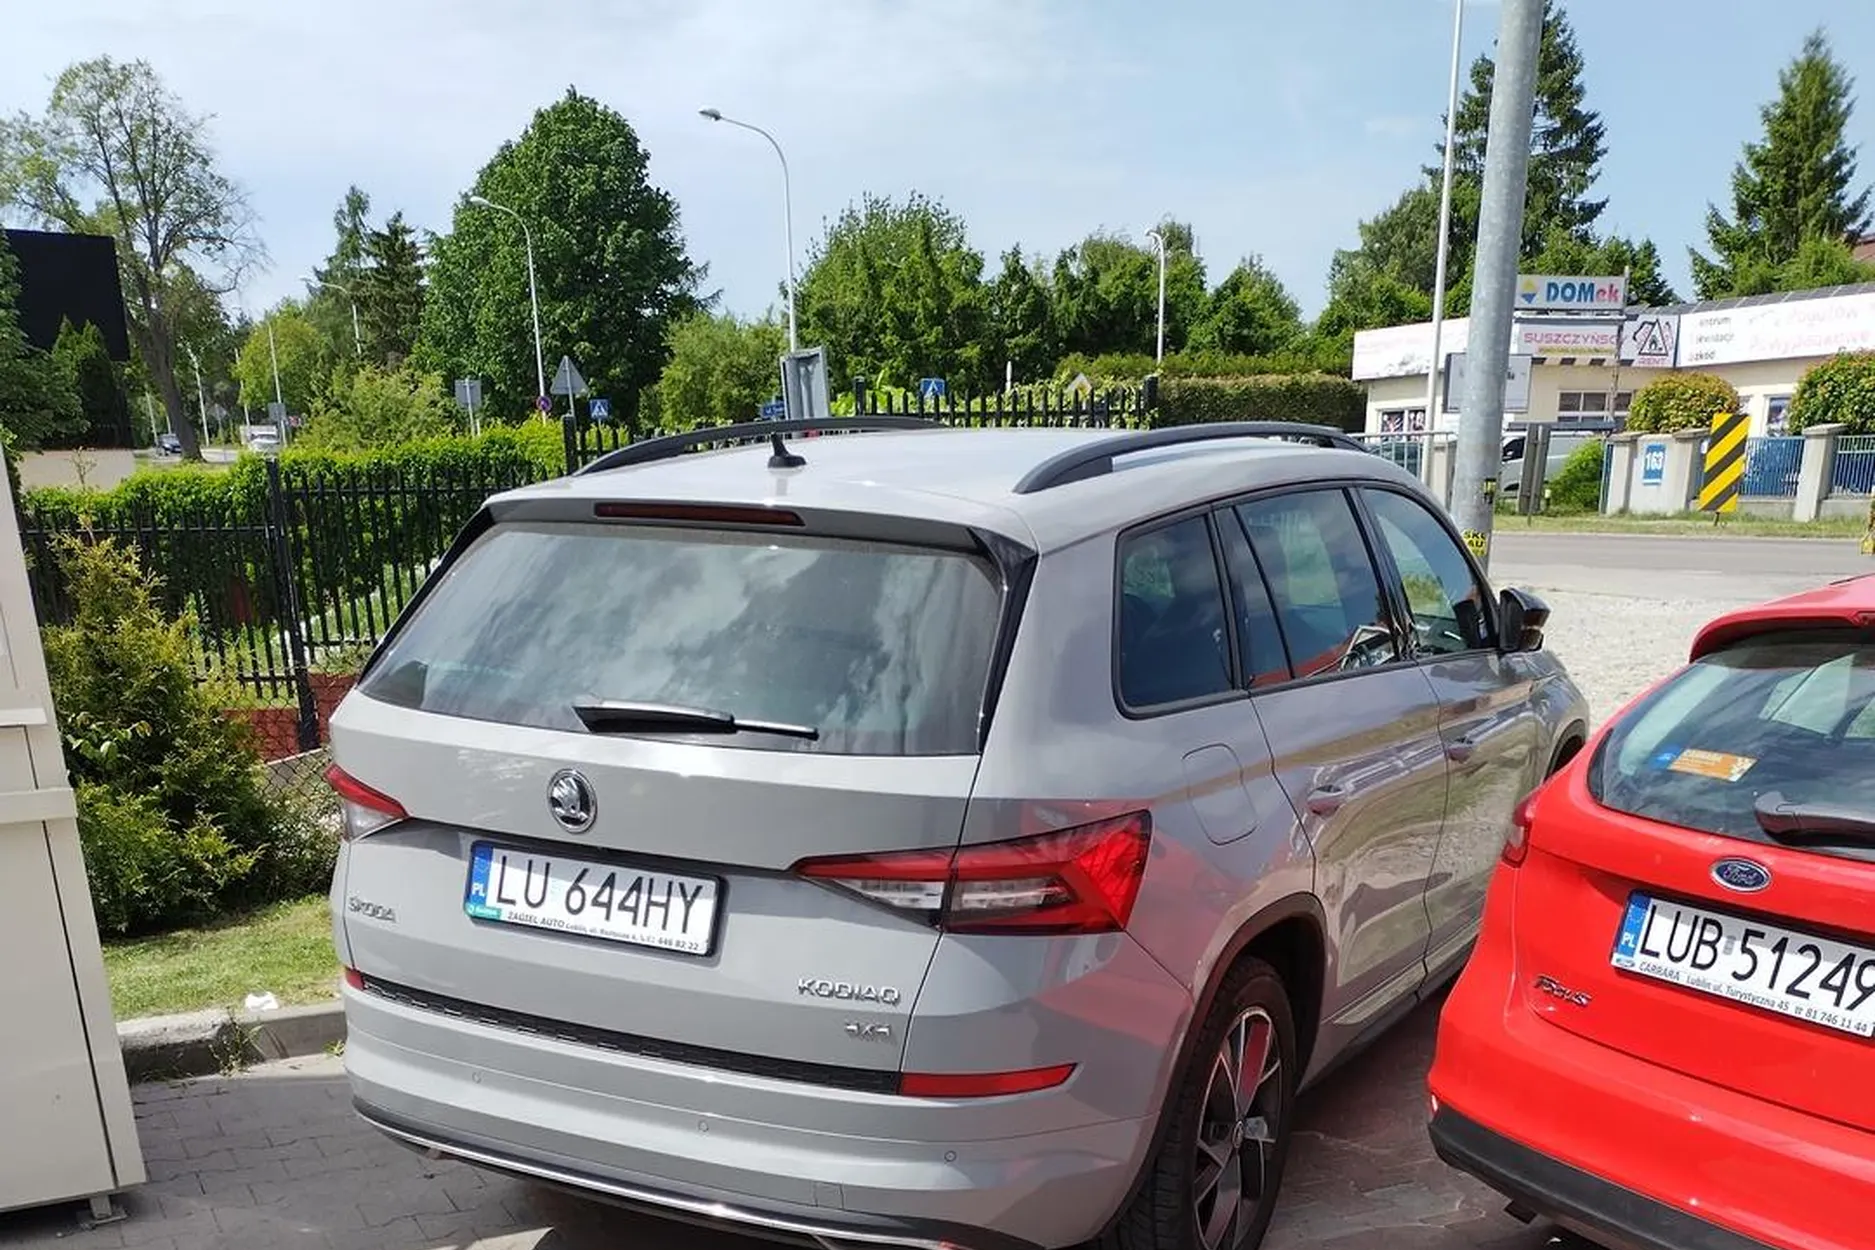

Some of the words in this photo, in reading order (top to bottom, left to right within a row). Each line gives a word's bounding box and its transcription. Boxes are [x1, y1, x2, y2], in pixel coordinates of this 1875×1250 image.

[1546, 282, 1619, 303] DOMek
[1646, 451, 1664, 470] 163
[472, 883, 487, 897] PL
[496, 855, 551, 908] LU
[565, 867, 703, 934] 644HY
[1621, 931, 1638, 948] PL
[1640, 904, 1723, 970] LUB
[1731, 928, 1875, 1011] 51249
[798, 979, 900, 1006] KODIAQ
[1777, 1000, 1789, 1011] 45
[1805, 1008, 1817, 1019] 81
[1820, 1011, 1838, 1024] 746
